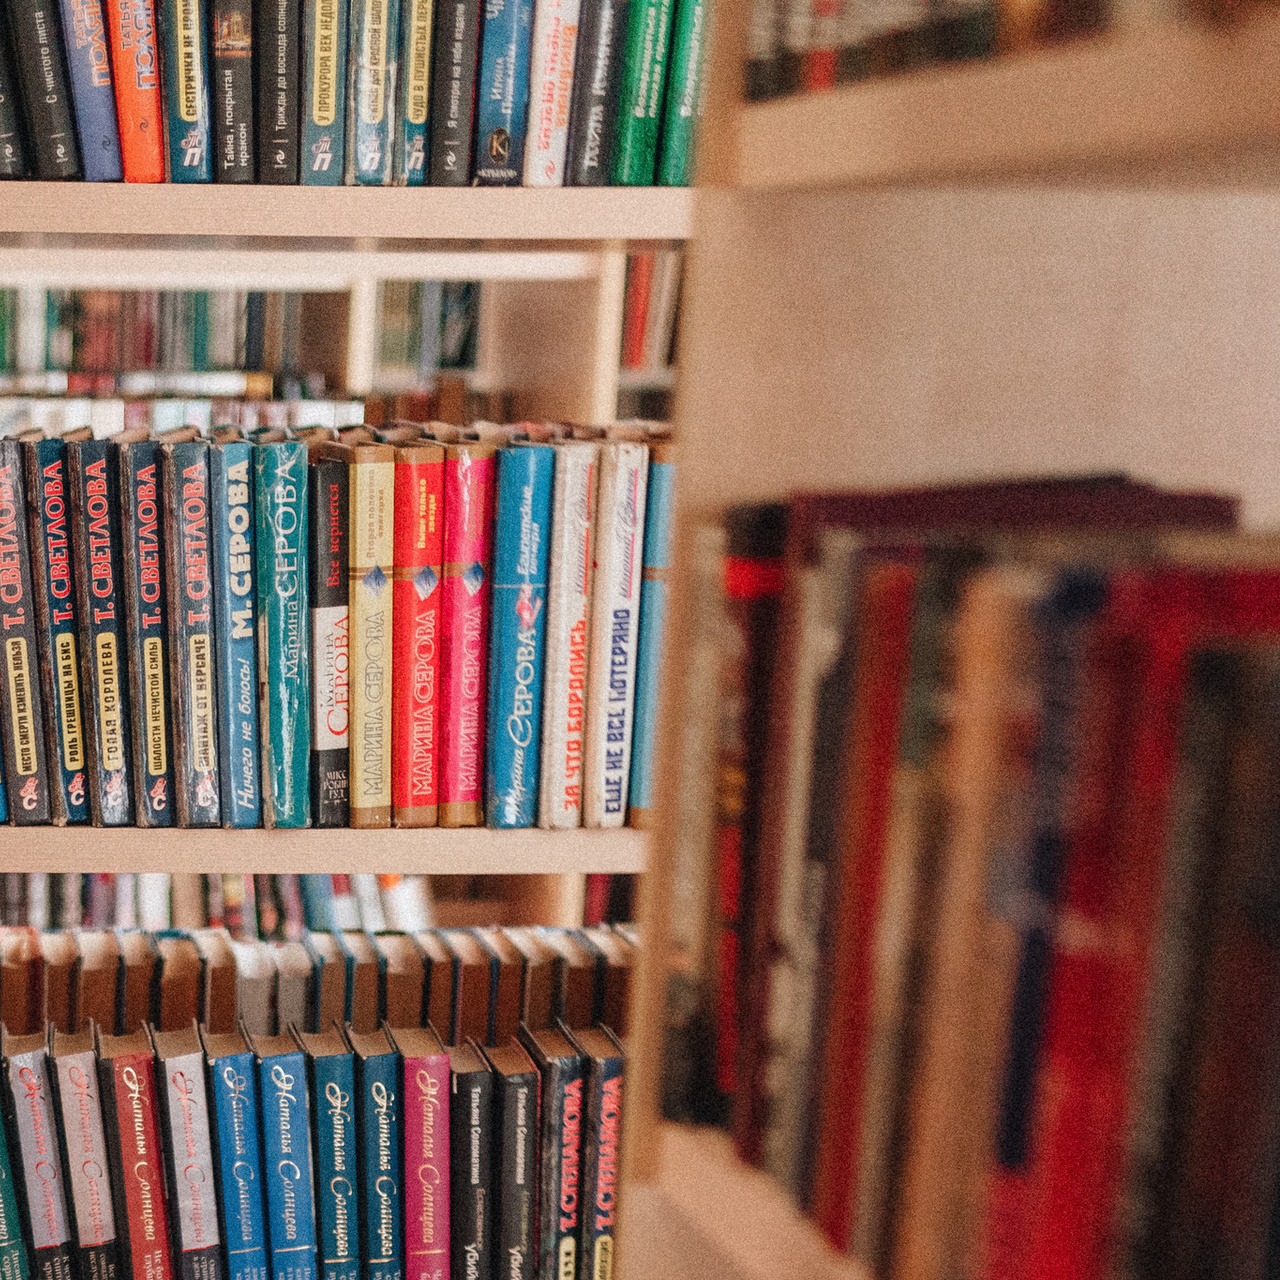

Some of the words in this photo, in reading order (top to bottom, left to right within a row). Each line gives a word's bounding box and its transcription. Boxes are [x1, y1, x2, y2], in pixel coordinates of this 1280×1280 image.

[35, 11, 49, 44] листа
[40, 47, 55, 89] чистого
[278, 37, 287, 75] восхода
[223, 69, 233, 125] покрытая
[276, 92, 287, 131] Трижды
[318, 62, 332, 113] ПРОКУРОРА
[239, 123, 248, 167] мраком
[43, 460, 72, 599] СВЕТЛОВА
[86, 460, 111, 598] СВЕТЛОВА
[135, 463, 160, 602] СВЕТЛОВА
[227, 459, 250, 597] СЕРОВА
[274, 459, 297, 599] СЕРОВА
[327, 484, 338, 553] вернется
[326, 561, 339, 587] Все
[11, 639, 22, 668] НЕЛЬЗЯ
[145, 642, 159, 671] СИЛЫ
[283, 597, 299, 679] Марина
[364, 609, 384, 702] СЕРОВА
[414, 609, 436, 703] СЕРОВА
[610, 608, 630, 703] ПОТЕРЯНО
[14, 671, 26, 714] ИЗМЕНИТЬ
[101, 640, 118, 713] КОРОЛЕВА
[146, 674, 160, 725] НЕЧИСТОЙ
[237, 658, 251, 714] боюсь!
[327, 616, 349, 737] СЕРОВА
[507, 628, 537, 748] СЕРОВА
[17, 717, 28, 746] СМЕРТИ
[62, 695, 78, 743] ГРЕШНИЦЫ
[107, 720, 120, 762] ГОЛАЯ
[19, 749, 32, 775] МЕСТО
[68, 746, 79, 770] РОЛЬ
[149, 728, 161, 770] ШАЛОСТИ
[364, 705, 384, 798] МАРИНА
[412, 704, 435, 798] МАРИНА
[237, 754, 255, 809] Ничего
[123, 1067, 149, 1156] Наталья
[271, 1065, 297, 1154] Наталья
[134, 1161, 157, 1241] Солнцева
[278, 1160, 301, 1240] Солнцева
